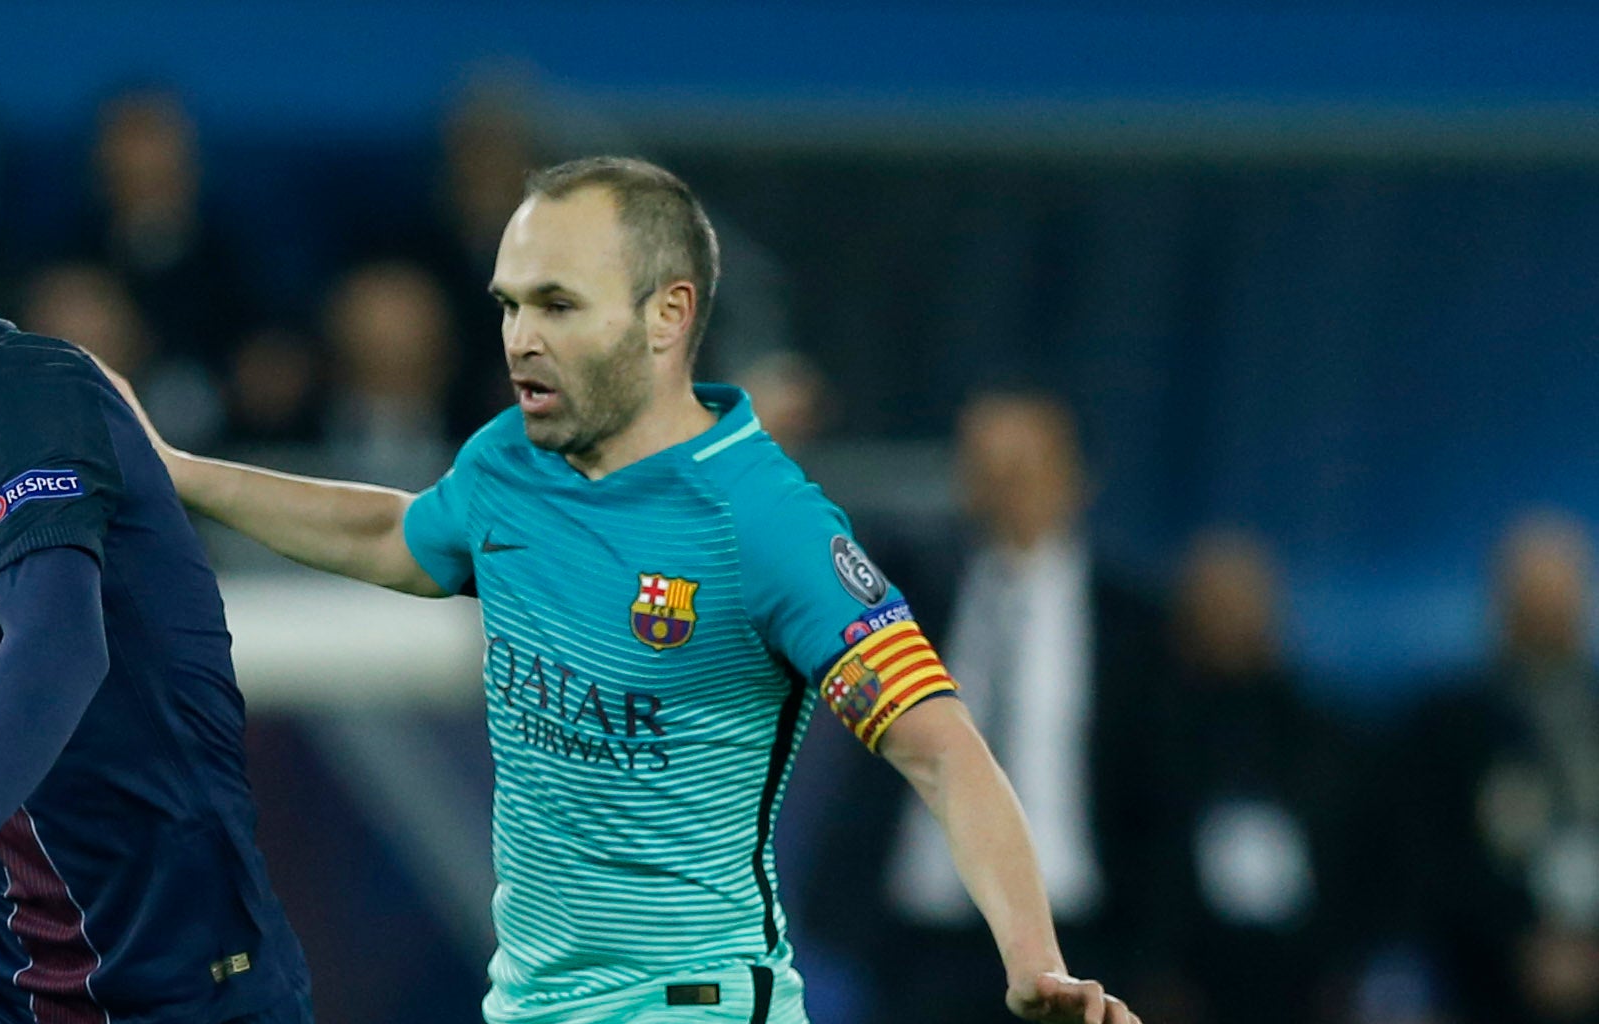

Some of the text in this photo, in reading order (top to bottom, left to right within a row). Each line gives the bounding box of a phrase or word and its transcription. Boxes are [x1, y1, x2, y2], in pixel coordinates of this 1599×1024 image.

[5, 476, 78, 504] RESPECT
[489, 636, 667, 738] QATAR
[515, 711, 670, 772] AIRWAYS
